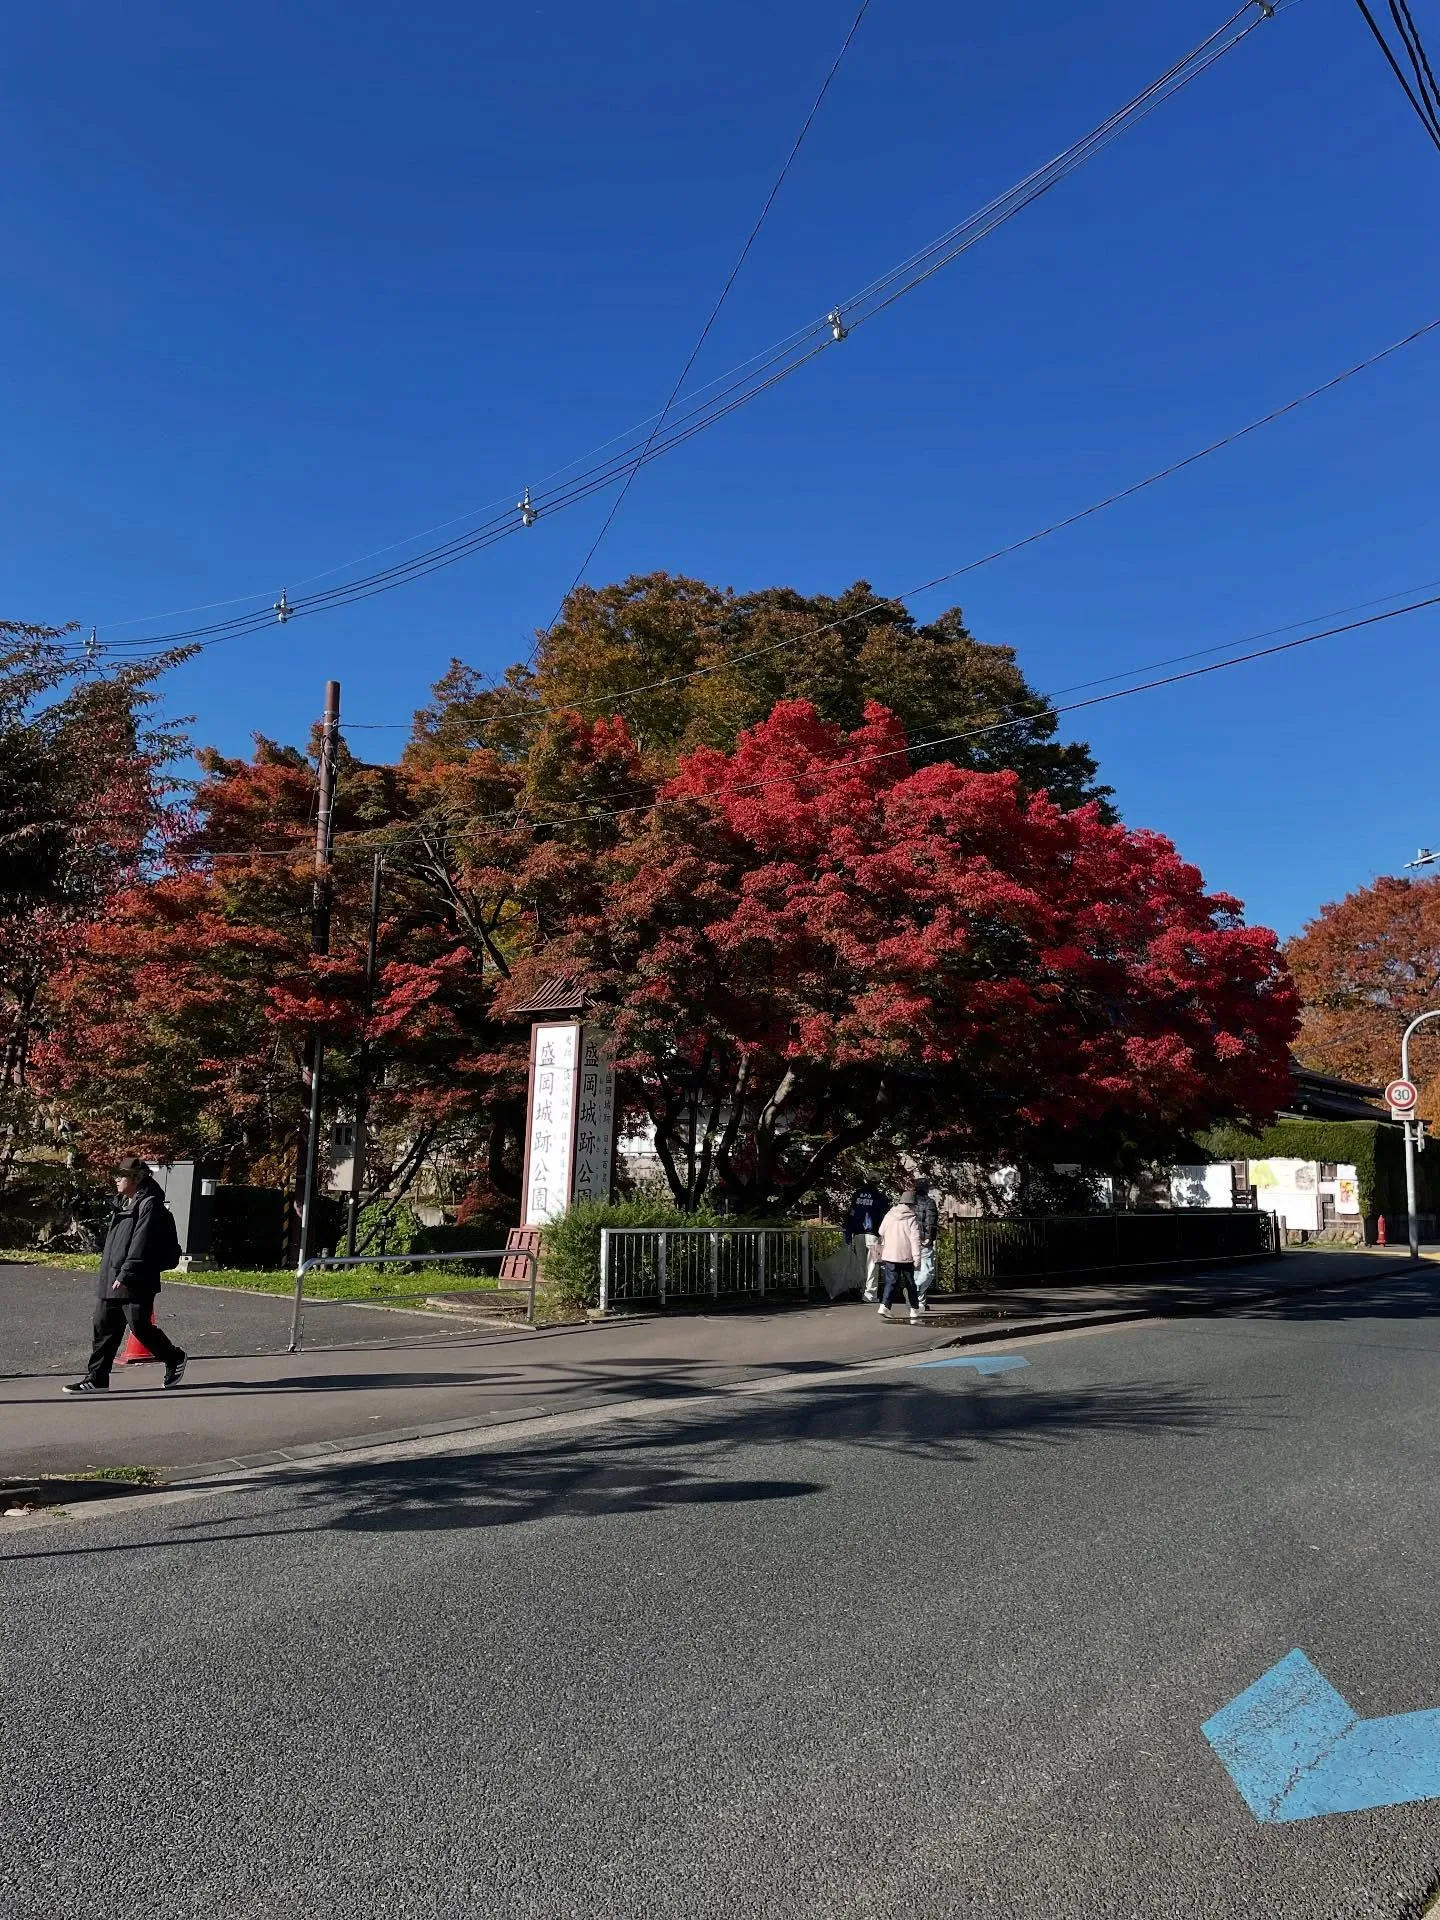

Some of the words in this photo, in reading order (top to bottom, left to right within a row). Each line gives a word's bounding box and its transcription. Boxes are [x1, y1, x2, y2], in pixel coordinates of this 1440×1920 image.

[532, 1041, 555, 1212] 盛岡城跡公園
[1394, 1089, 1410, 1101] 30
